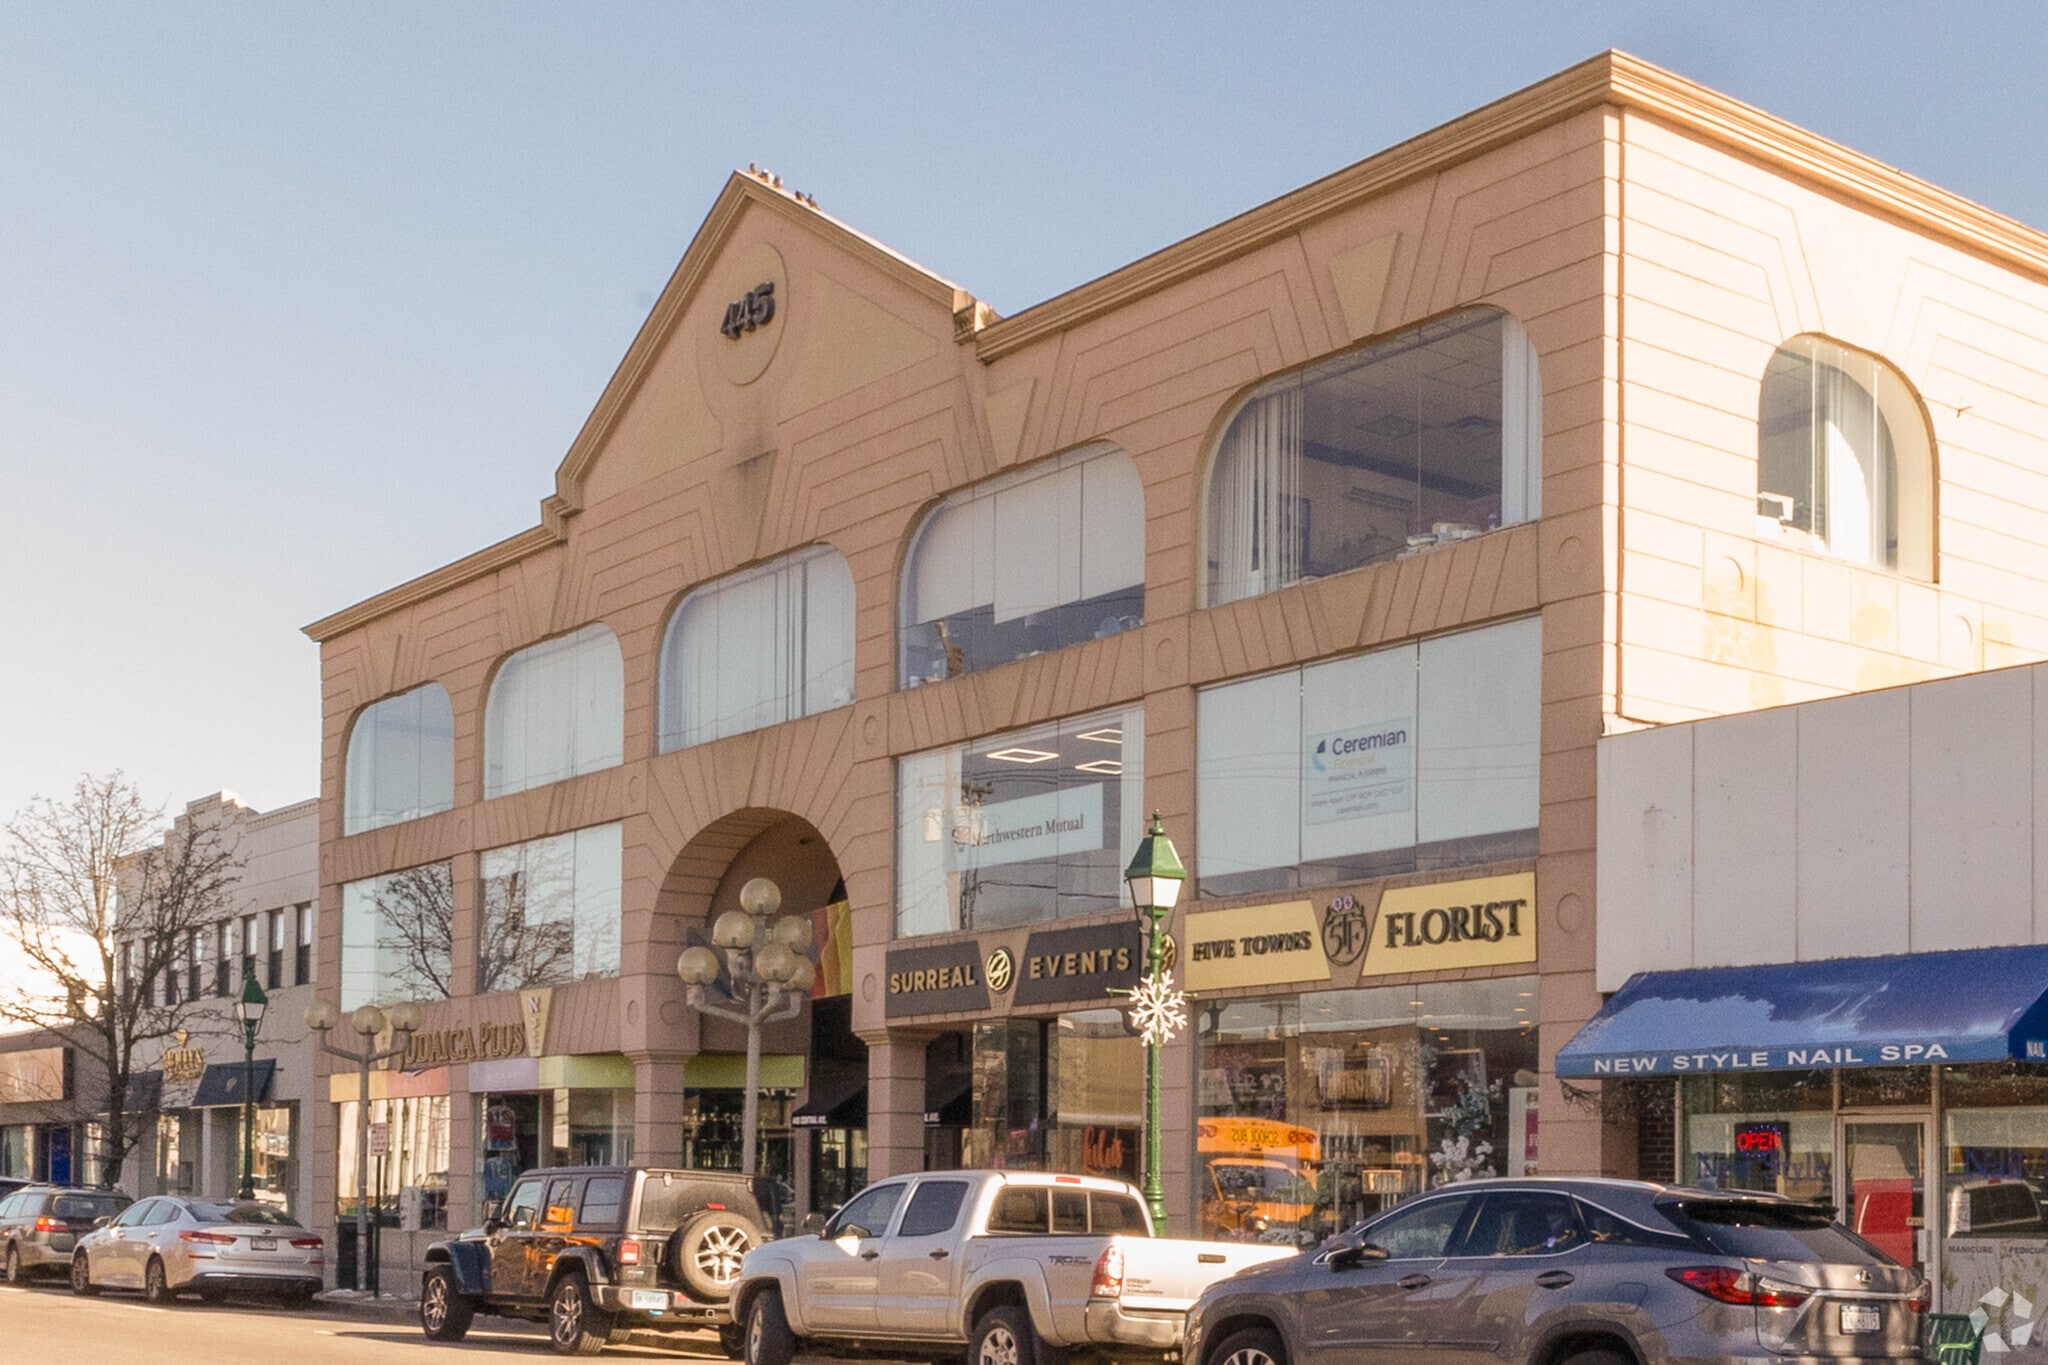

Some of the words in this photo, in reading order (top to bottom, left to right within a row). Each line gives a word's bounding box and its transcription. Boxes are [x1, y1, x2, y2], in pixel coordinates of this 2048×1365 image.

[721, 281, 775, 340] 445
[1332, 730, 1407, 755] Ceremian
[970, 824, 1043, 848] Nrthwestern
[1045, 813, 1084, 836] Mutual
[1192, 939, 1235, 961] FIVE
[1240, 930, 1312, 956] TOWNS
[1384, 898, 1527, 948] FLORIST
[890, 965, 977, 994] SURREAL
[1030, 947, 1131, 980] EVENTS
[1594, 1057, 1658, 1073] NEW
[1672, 1051, 1769, 1070] STYLE
[1787, 1048, 1863, 1065] NAIL
[1880, 1043, 1948, 1061] SPA
[1737, 1132, 1782, 1150] OPEN
